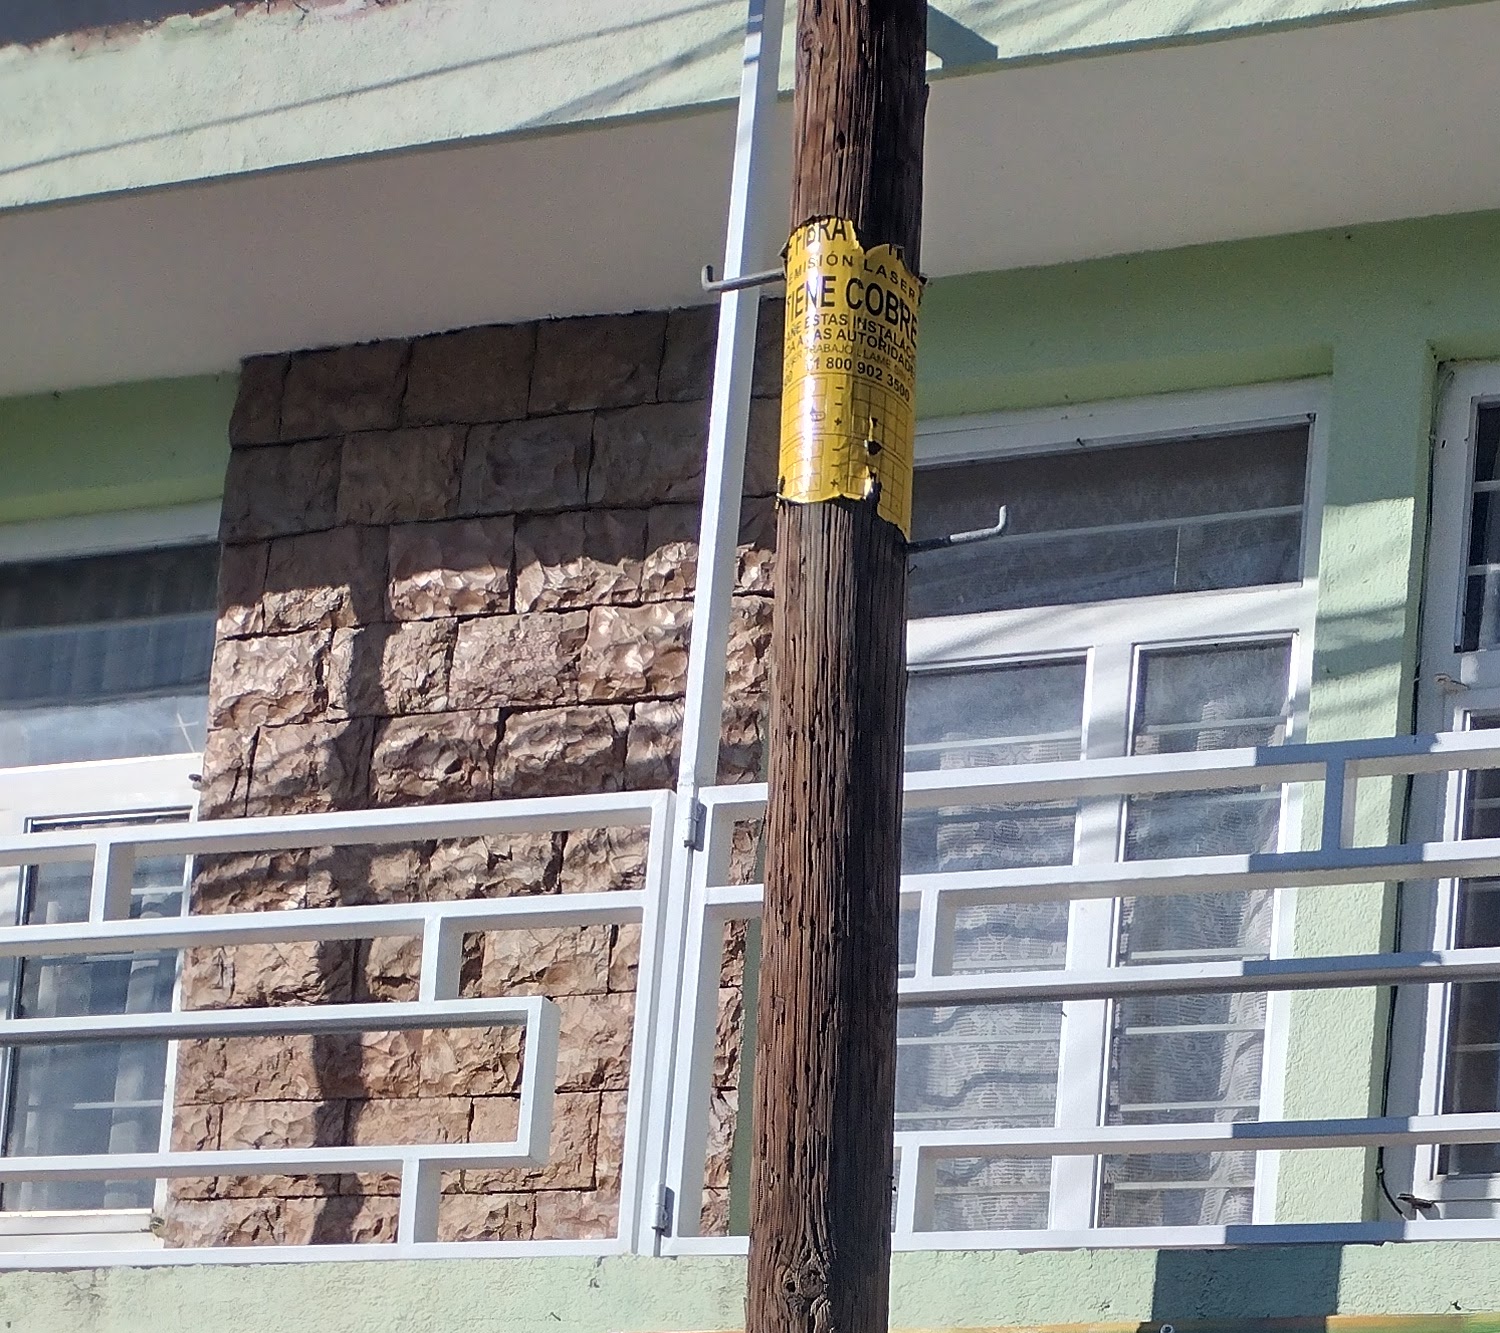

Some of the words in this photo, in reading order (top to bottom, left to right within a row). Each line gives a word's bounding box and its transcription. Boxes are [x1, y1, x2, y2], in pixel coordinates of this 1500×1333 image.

[864, 258, 916, 303] LASER
[845, 277, 917, 348] COBRE
[826, 356, 852, 371] 800
[857, 361, 883, 381] 902
